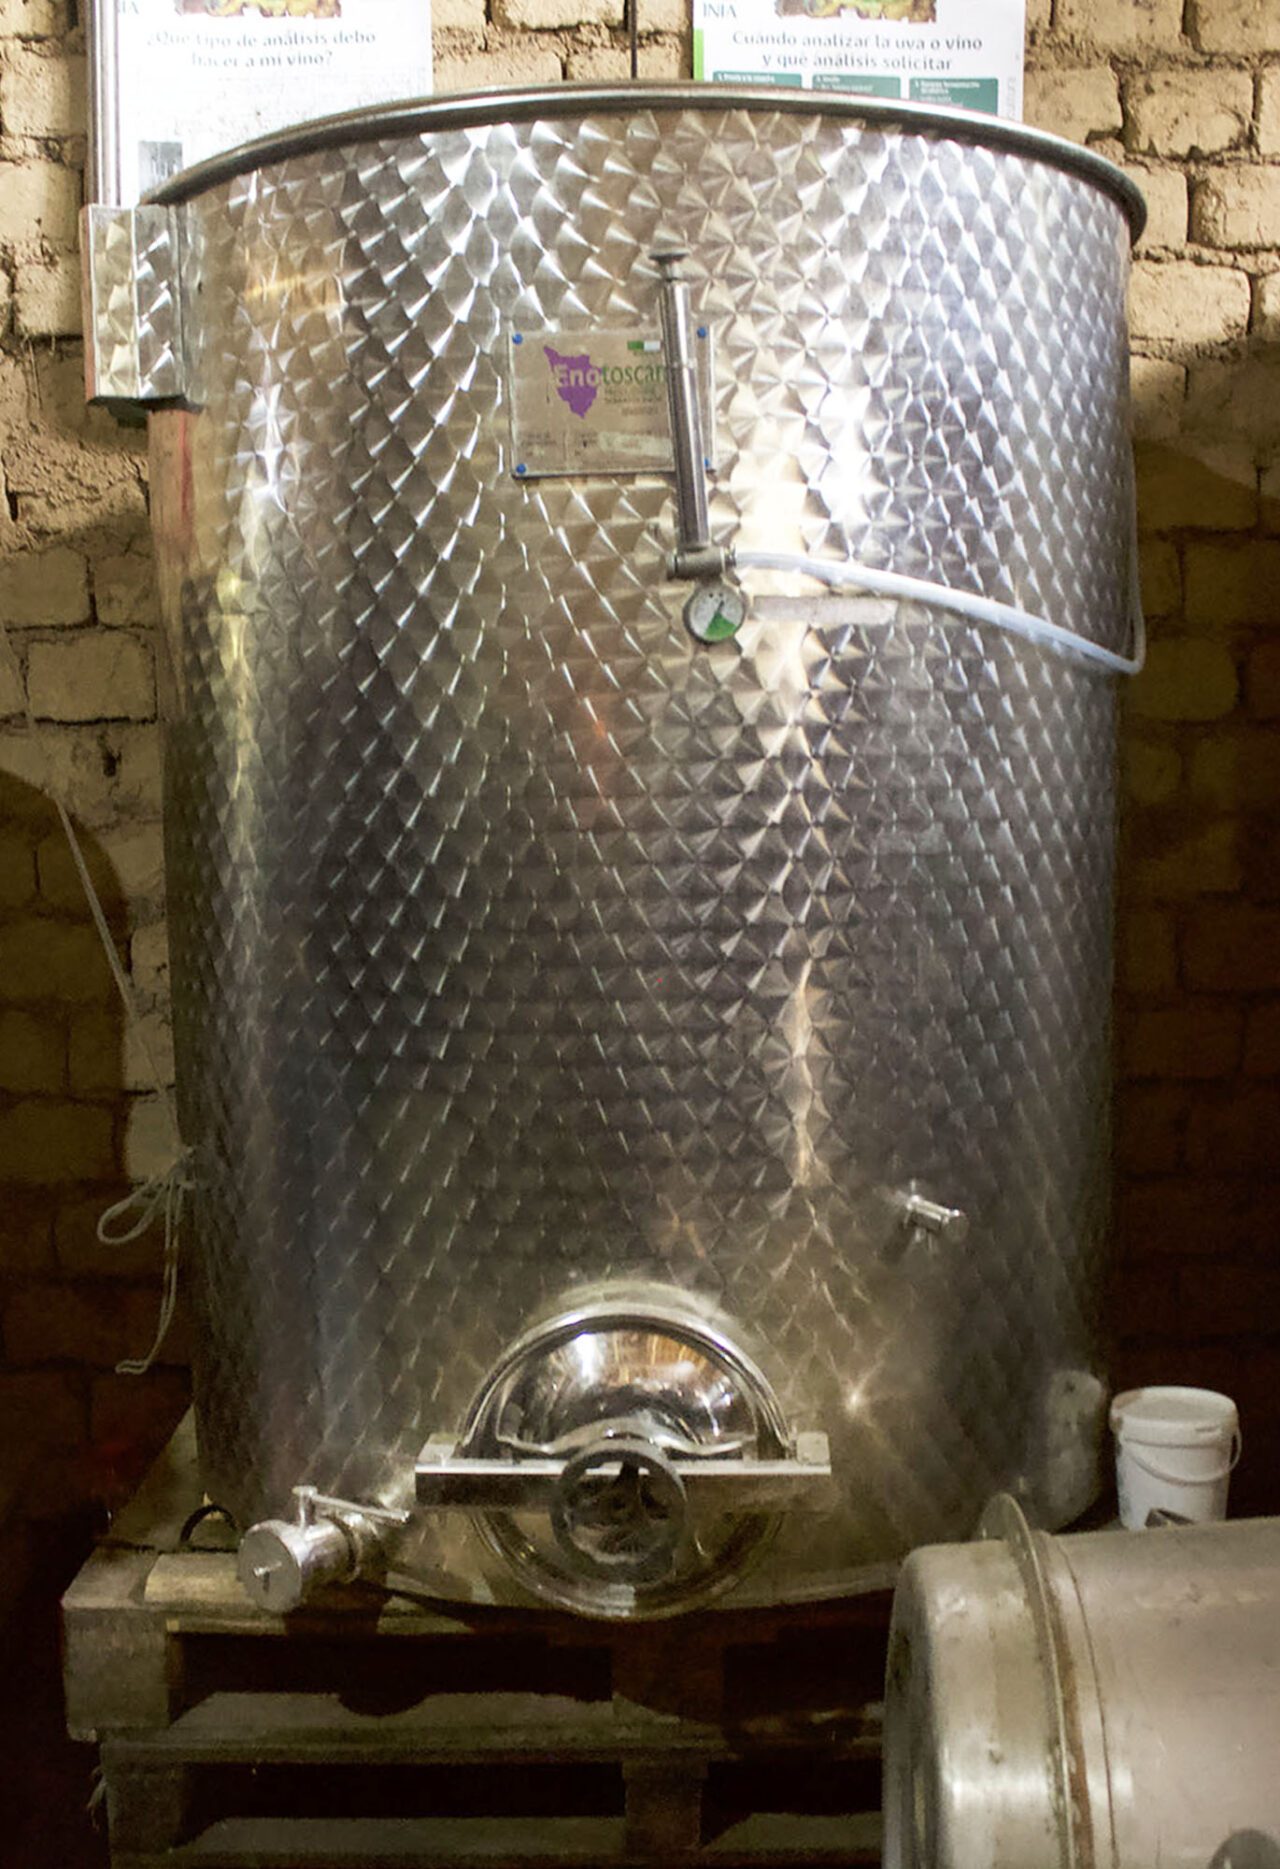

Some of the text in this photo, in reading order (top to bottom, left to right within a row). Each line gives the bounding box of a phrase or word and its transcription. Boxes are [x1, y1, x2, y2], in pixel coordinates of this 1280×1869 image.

[196, 32, 231, 50] tipo
[236, 33, 257, 48] de
[333, 29, 376, 45] debo
[802, 32, 870, 48] analizar
[875, 34, 890, 49] la
[895, 38, 925, 50] uva
[929, 38, 941, 51] o
[945, 34, 983, 51] vino
[191, 49, 333, 68] hacer a mi vino?
[762, 54, 772, 67] y
[882, 55, 952, 71] solicitar
